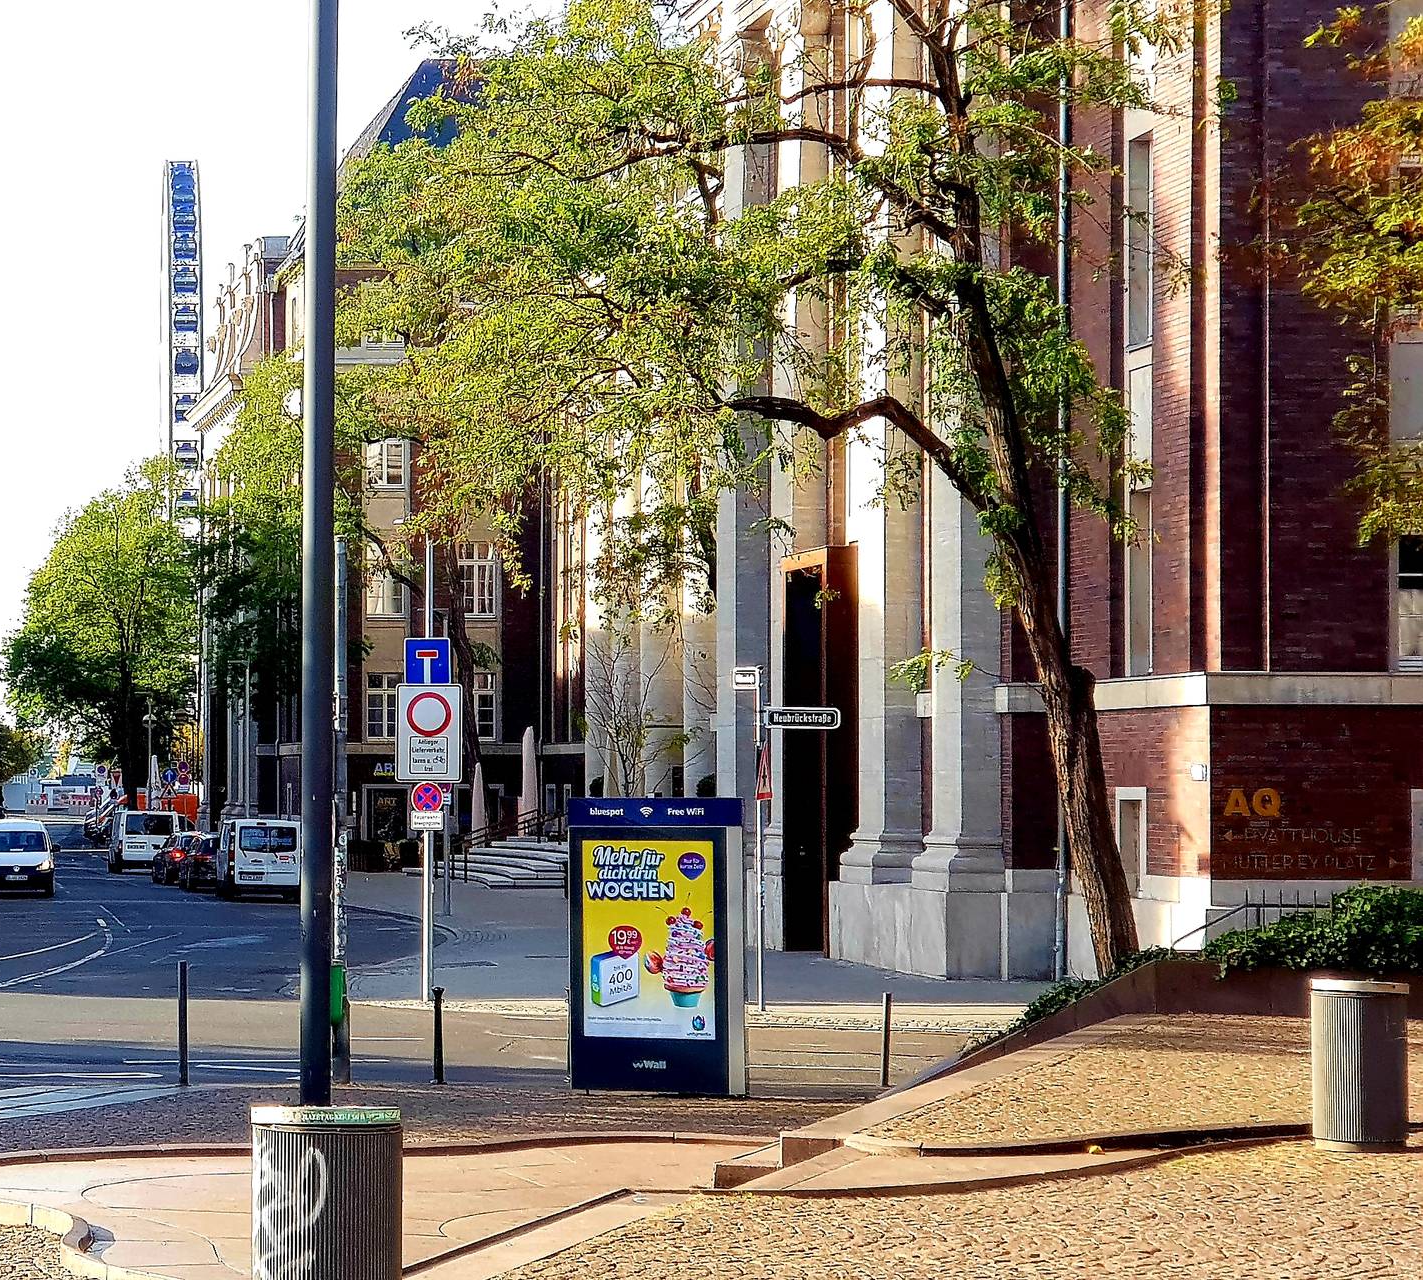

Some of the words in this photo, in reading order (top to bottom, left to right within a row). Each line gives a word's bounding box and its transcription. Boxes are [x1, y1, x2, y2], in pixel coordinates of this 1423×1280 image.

[773, 713, 832, 724] Neubrückstraße
[375, 762, 396, 772] AR
[1223, 787, 1282, 817] AQ
[589, 807, 624, 817] bluespot
[667, 808, 685, 816] Free
[686, 807, 705, 816] WiFi
[594, 846, 639, 866] Mehr
[637, 848, 665, 870] für
[599, 866, 627, 880] dich
[628, 866, 657, 880] drin
[586, 881, 674, 899] WOCHEN
[609, 968, 633, 985] 400
